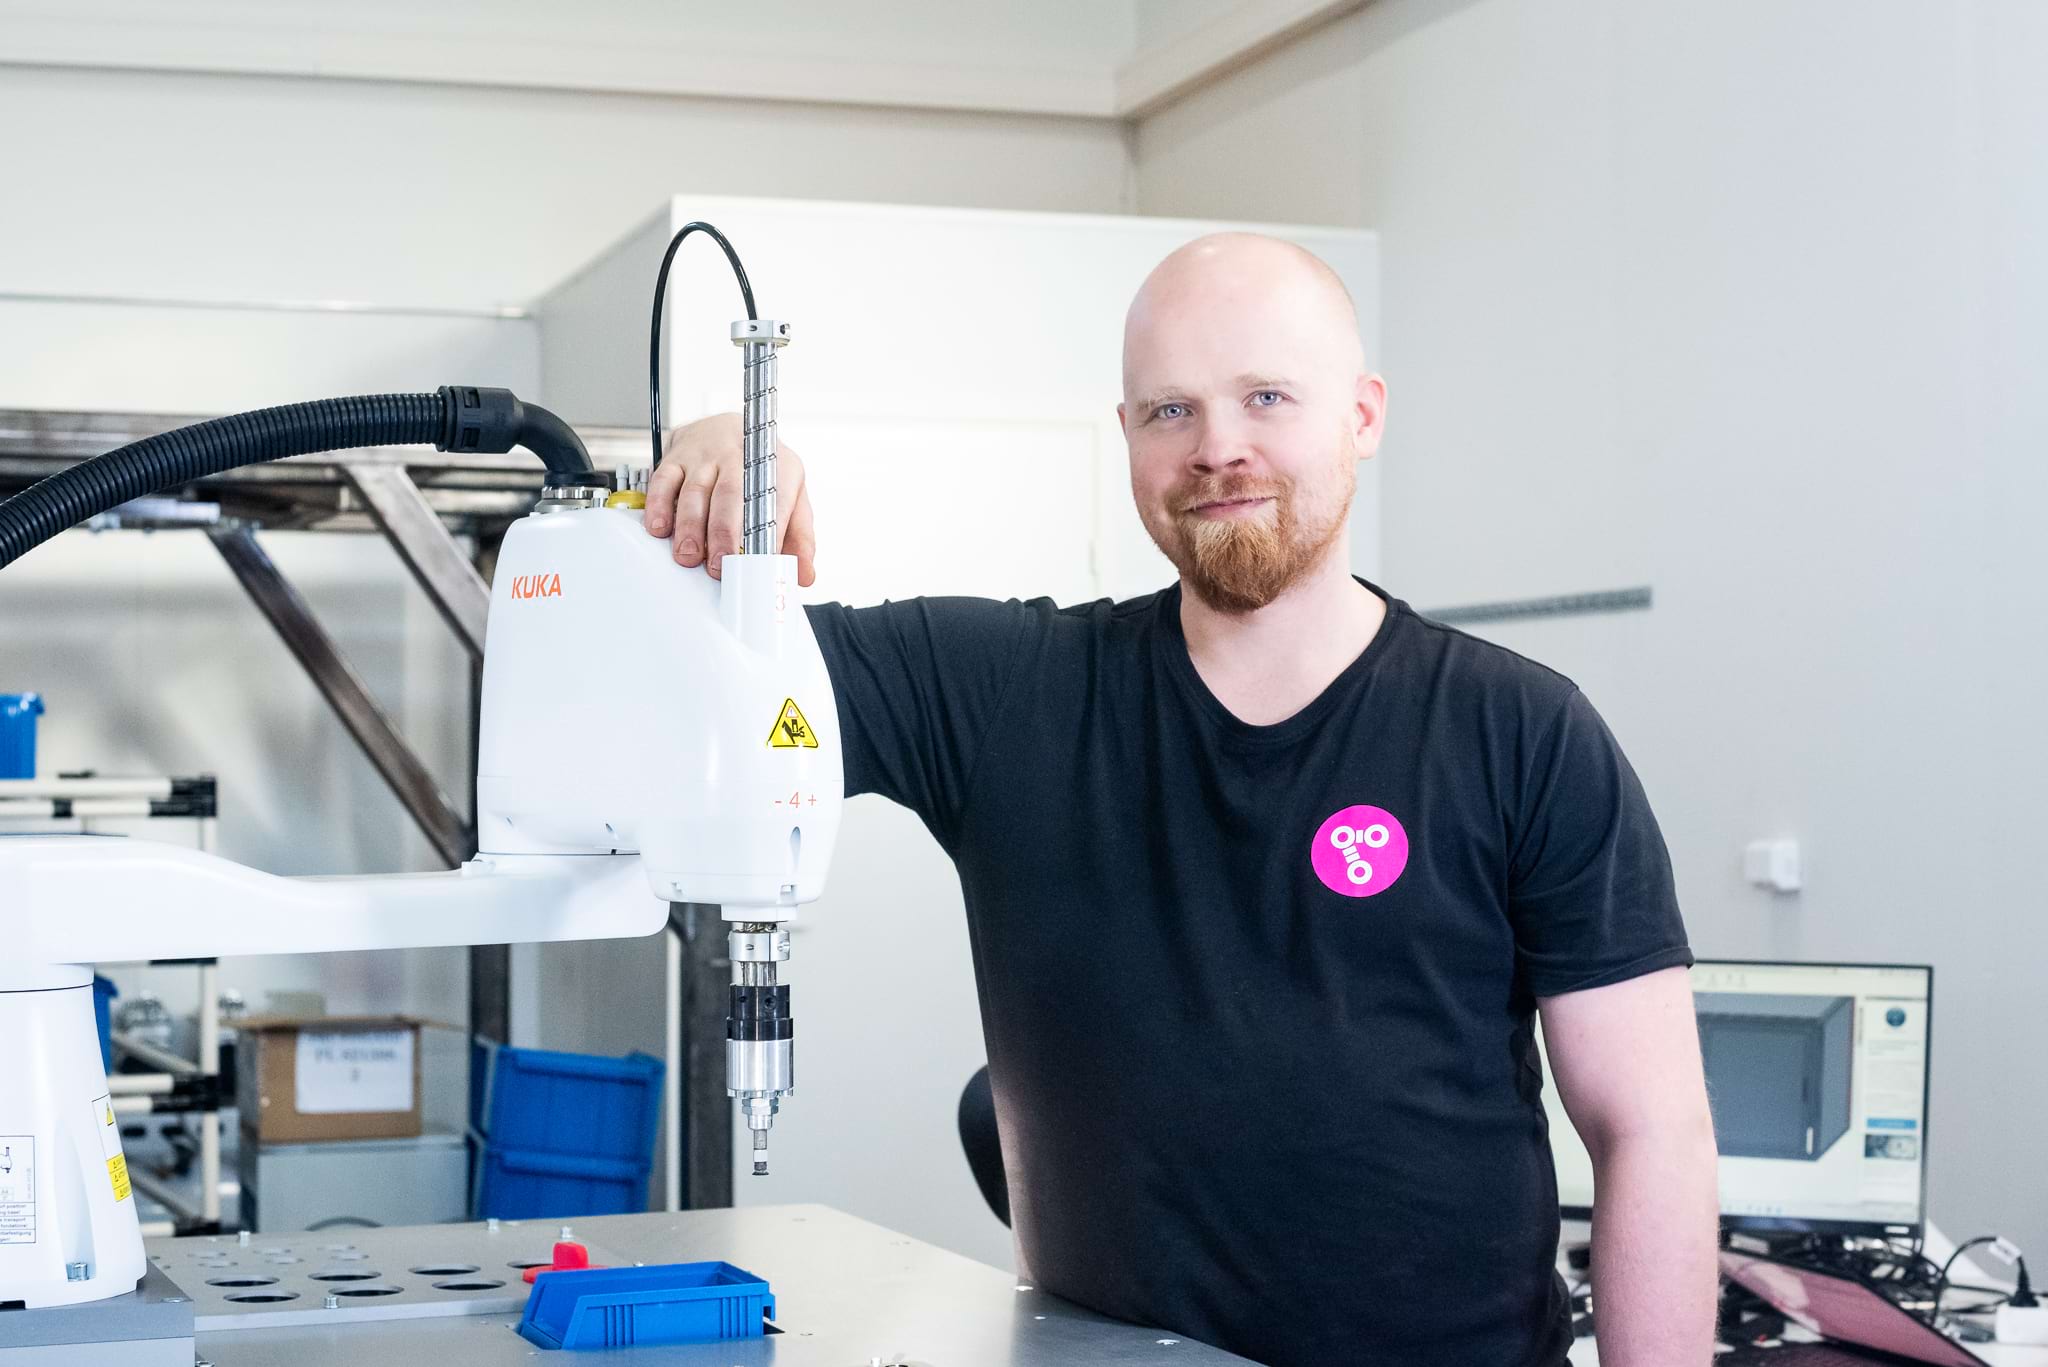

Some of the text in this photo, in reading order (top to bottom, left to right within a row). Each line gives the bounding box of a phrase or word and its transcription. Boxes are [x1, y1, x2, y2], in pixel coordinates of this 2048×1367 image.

[511, 574, 562, 599] KUKA
[775, 594, 785, 611] 3
[789, 792, 801, 809] 4
